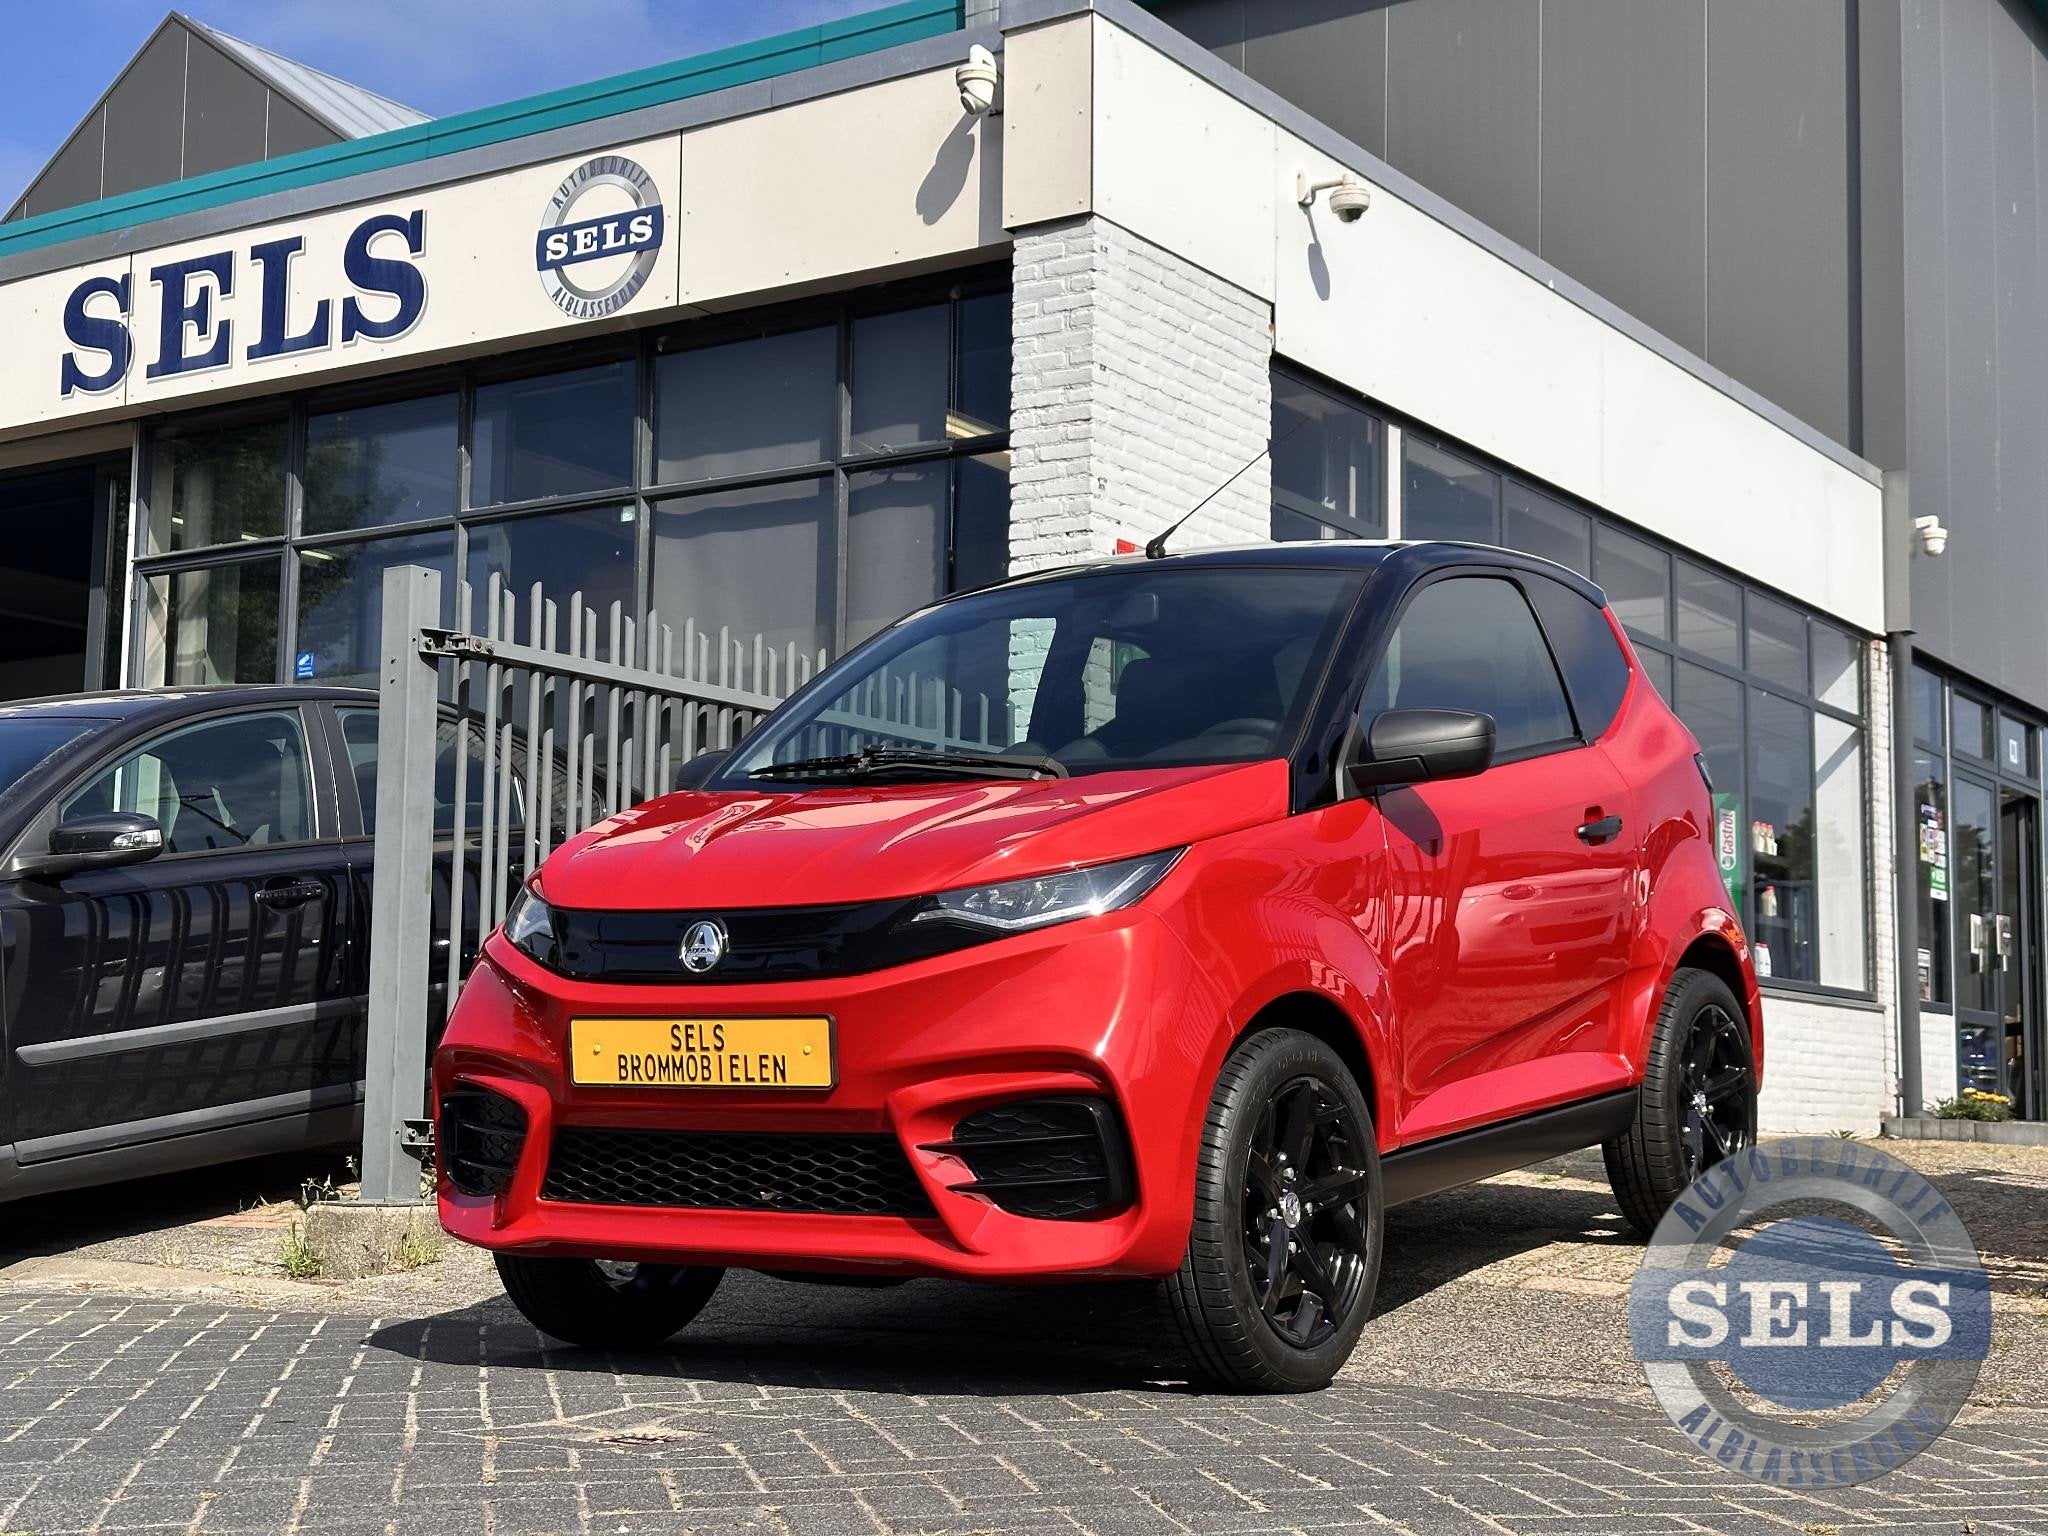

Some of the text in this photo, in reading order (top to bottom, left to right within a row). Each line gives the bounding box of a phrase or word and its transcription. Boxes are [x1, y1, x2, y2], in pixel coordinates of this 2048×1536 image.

[552, 156, 651, 210] AUTOBEDRIJF
[546, 214, 653, 261] SELS
[61, 208, 427, 397] SELS
[552, 269, 645, 318] ALBLASSERDAM
[1722, 811, 1734, 855] Castrol
[670, 1023, 725, 1052] SELS
[618, 1054, 786, 1083] BROMMOBIELEN
